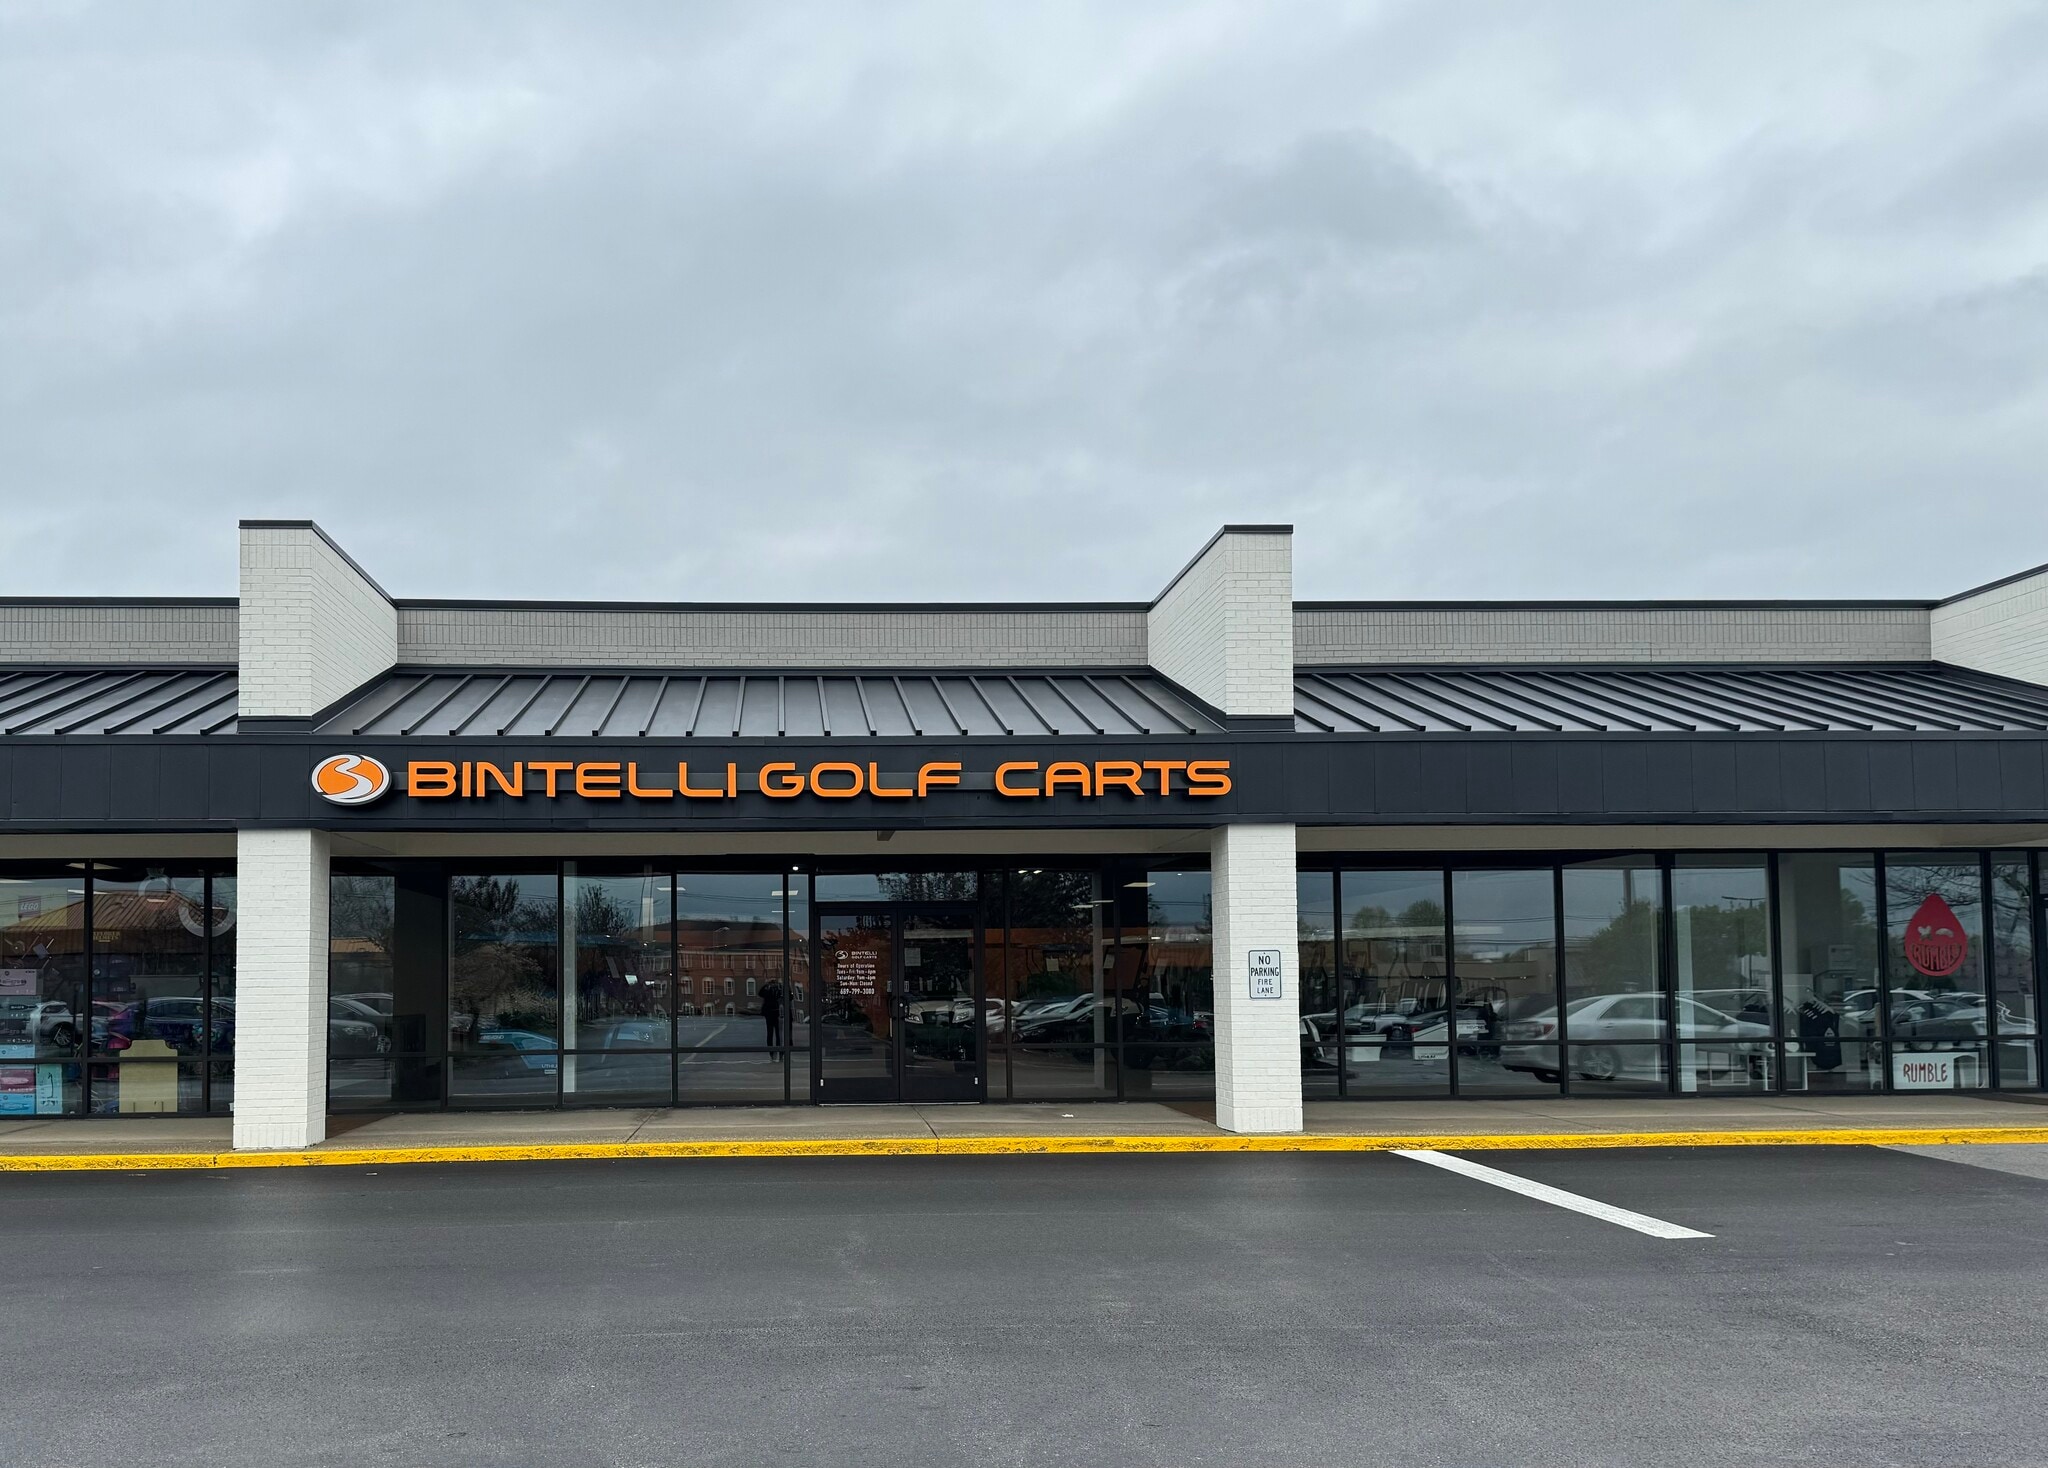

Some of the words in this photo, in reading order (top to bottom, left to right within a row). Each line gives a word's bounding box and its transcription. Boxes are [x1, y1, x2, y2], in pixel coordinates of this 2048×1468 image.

[407, 761, 737, 798] BINTELLI
[758, 761, 962, 798] GOLF
[995, 760, 1232, 797] CARTS
[1258, 955, 1271, 965] NO
[1912, 943, 1961, 972] RUMBLE
[1250, 967, 1280, 977] PARKING
[1257, 978, 1273, 986] FIRE
[1257, 986, 1274, 994] LANE
[1903, 1062, 1949, 1083] RUMBLE
